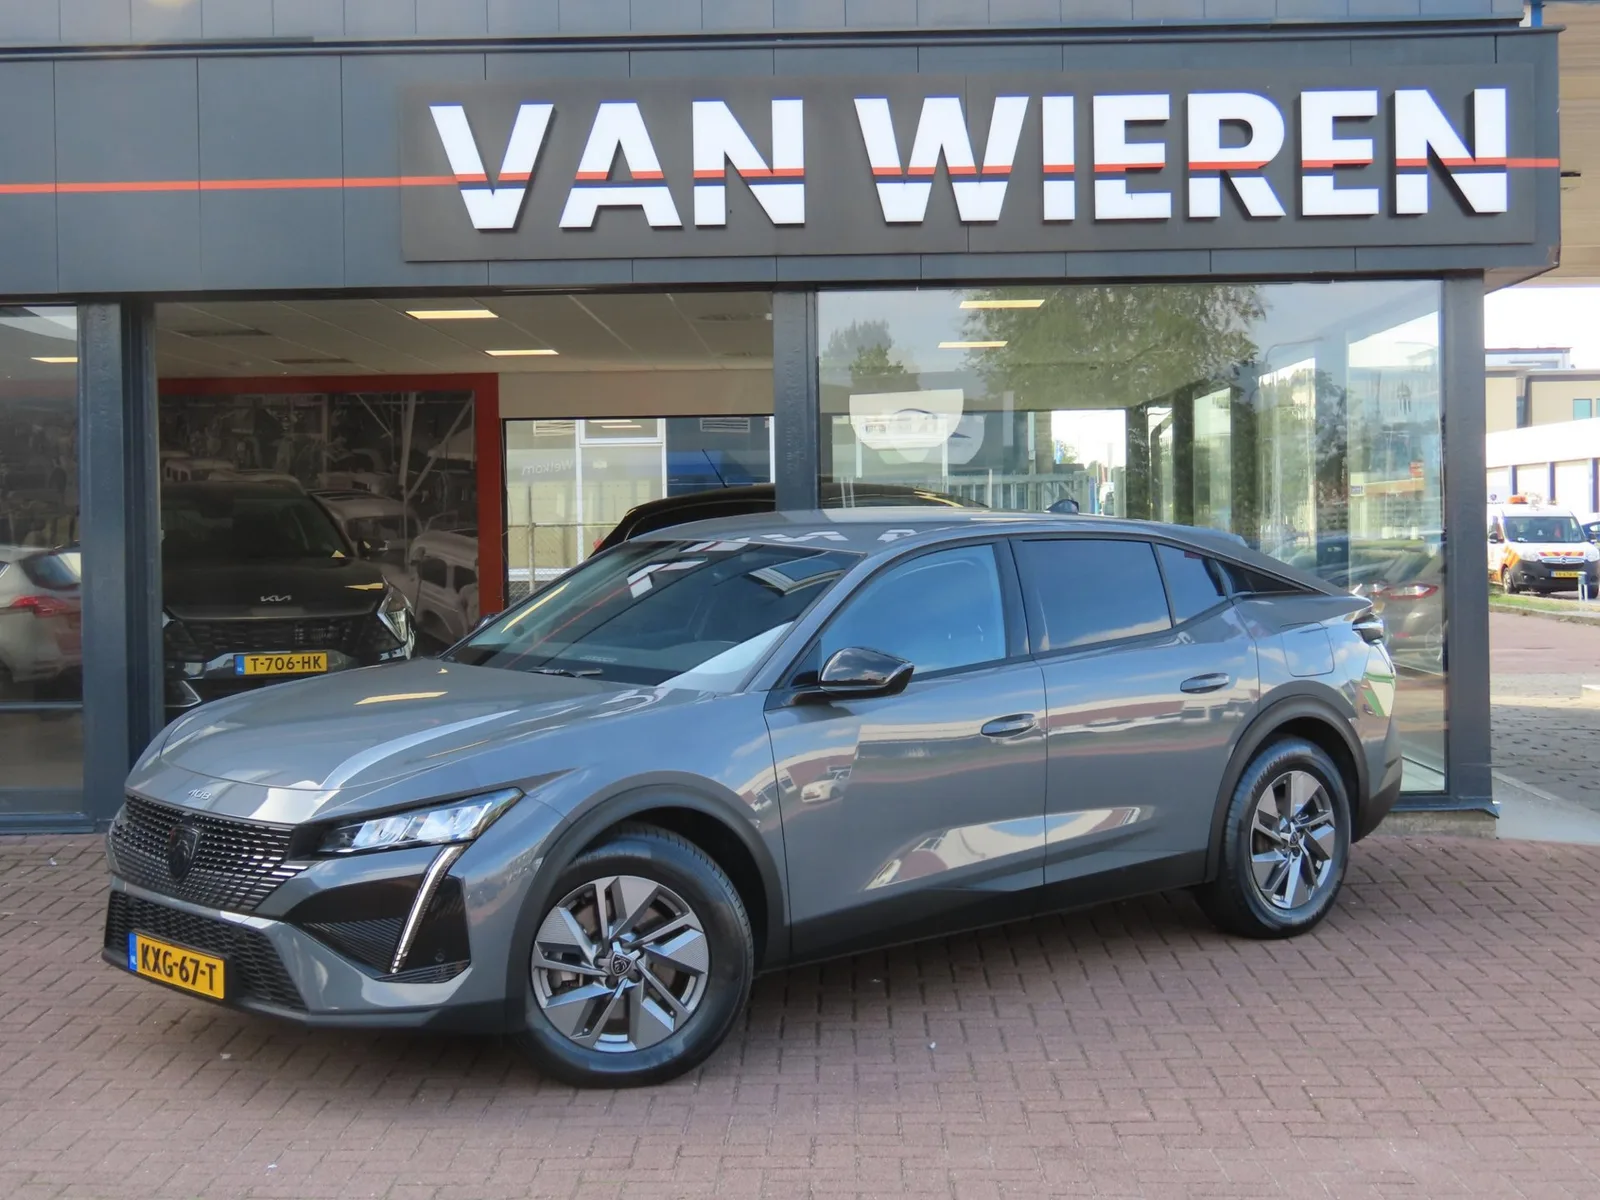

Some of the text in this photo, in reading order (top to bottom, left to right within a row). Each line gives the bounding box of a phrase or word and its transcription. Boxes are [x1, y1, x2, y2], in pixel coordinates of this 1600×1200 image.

[430, 87, 1508, 230] VAN WIEREN
[250, 656, 322, 672] T-706-HK
[141, 943, 217, 991] KXG-67-T
